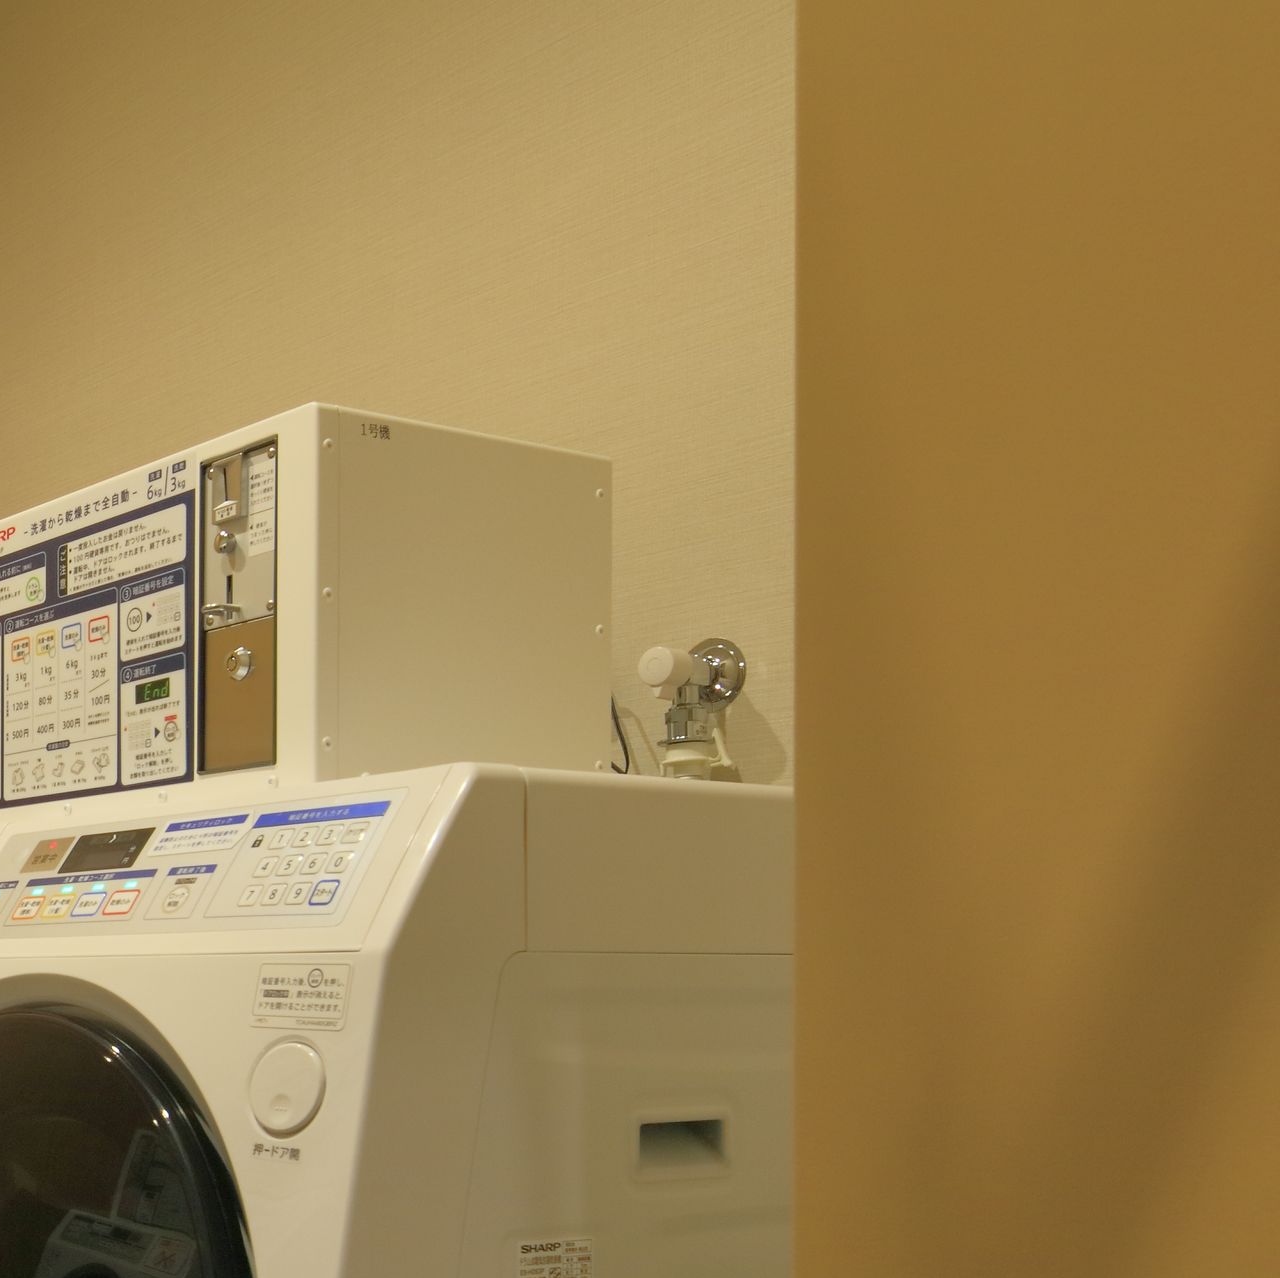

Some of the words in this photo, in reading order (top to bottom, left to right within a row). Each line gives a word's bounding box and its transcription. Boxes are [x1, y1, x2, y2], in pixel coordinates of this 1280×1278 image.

[361, 424, 390, 440] 1号機
[146, 481, 162, 501] 6kg
[170, 472, 186, 493] 3kg
[128, 614, 140, 625] 100
[12, 699, 29, 711] 120分
[38, 694, 52, 706] 80分
[63, 688, 79, 701] 35分
[91, 667, 106, 679] 30分
[91, 694, 110, 706] 100円
[12, 727, 29, 740] 500円
[36, 722, 54, 734] 400円
[62, 717, 80, 730] 300円
[275, 833, 286, 843] 1
[299, 830, 310, 841] 2
[323, 828, 335, 839] 3
[259, 861, 270, 871] 4
[283, 859, 294, 870] 5
[307, 858, 318, 869] 6
[244, 890, 255, 900] 7
[267, 888, 279, 899] 8
[292, 887, 303, 898] 9
[520, 1242, 562, 1254] SHARP
